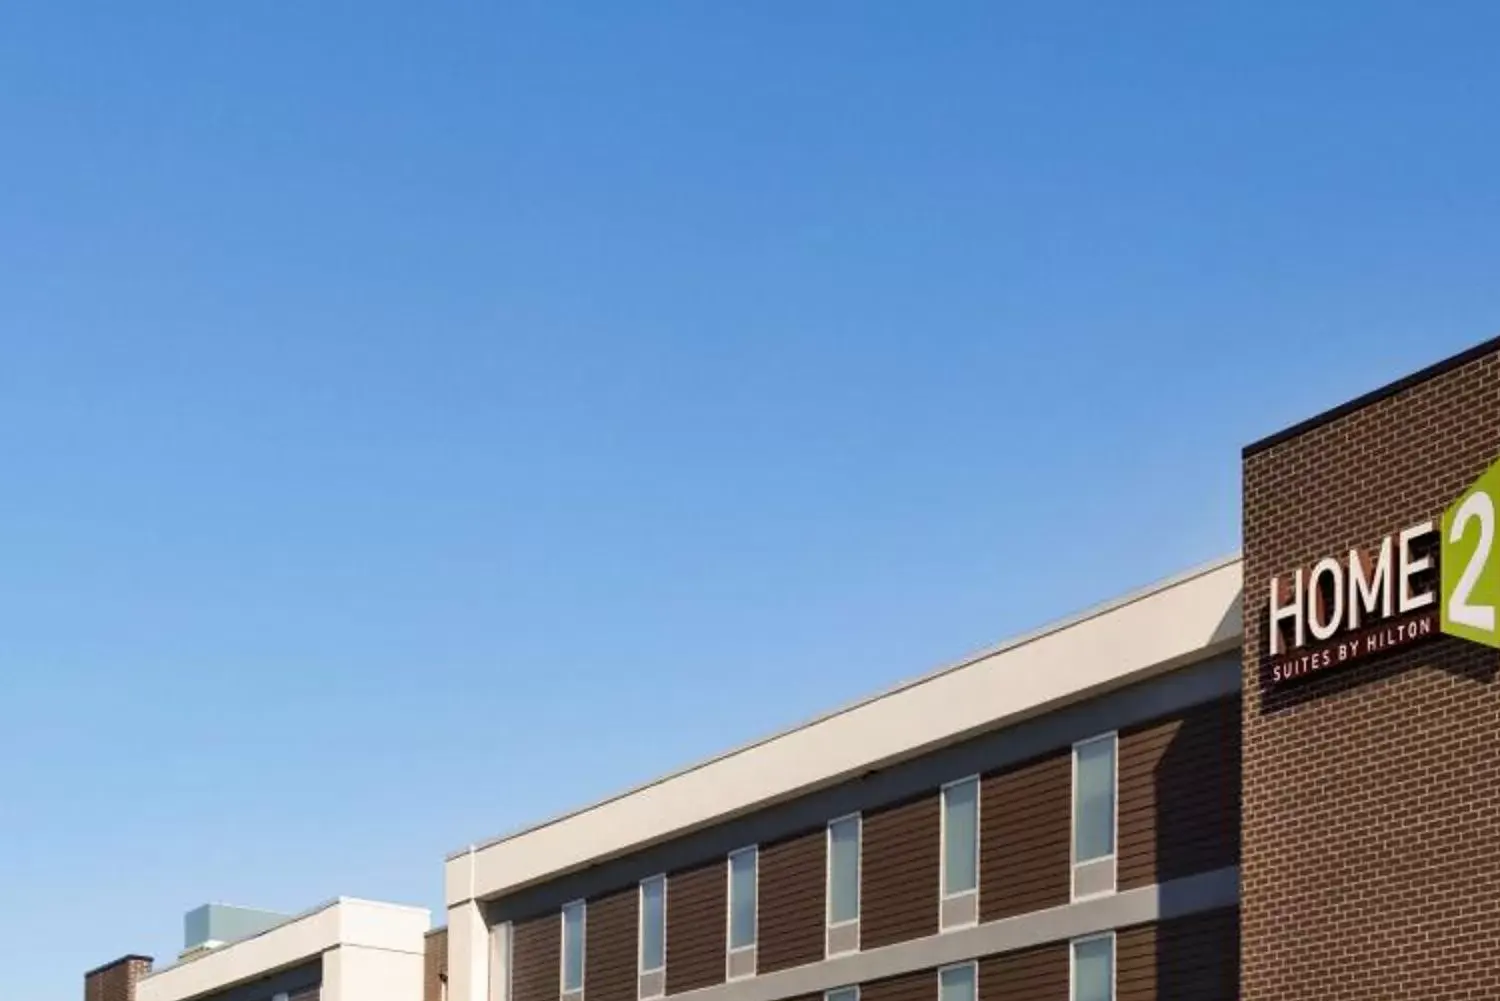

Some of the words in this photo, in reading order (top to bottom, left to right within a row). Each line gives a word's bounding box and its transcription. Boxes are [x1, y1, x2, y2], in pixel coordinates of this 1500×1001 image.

[1269, 521, 1434, 656] HOME
[1448, 490, 1495, 632] 2
[1273, 650, 1331, 682] SUITES
[1338, 640, 1360, 661] BY
[1367, 617, 1432, 653] HILTON
